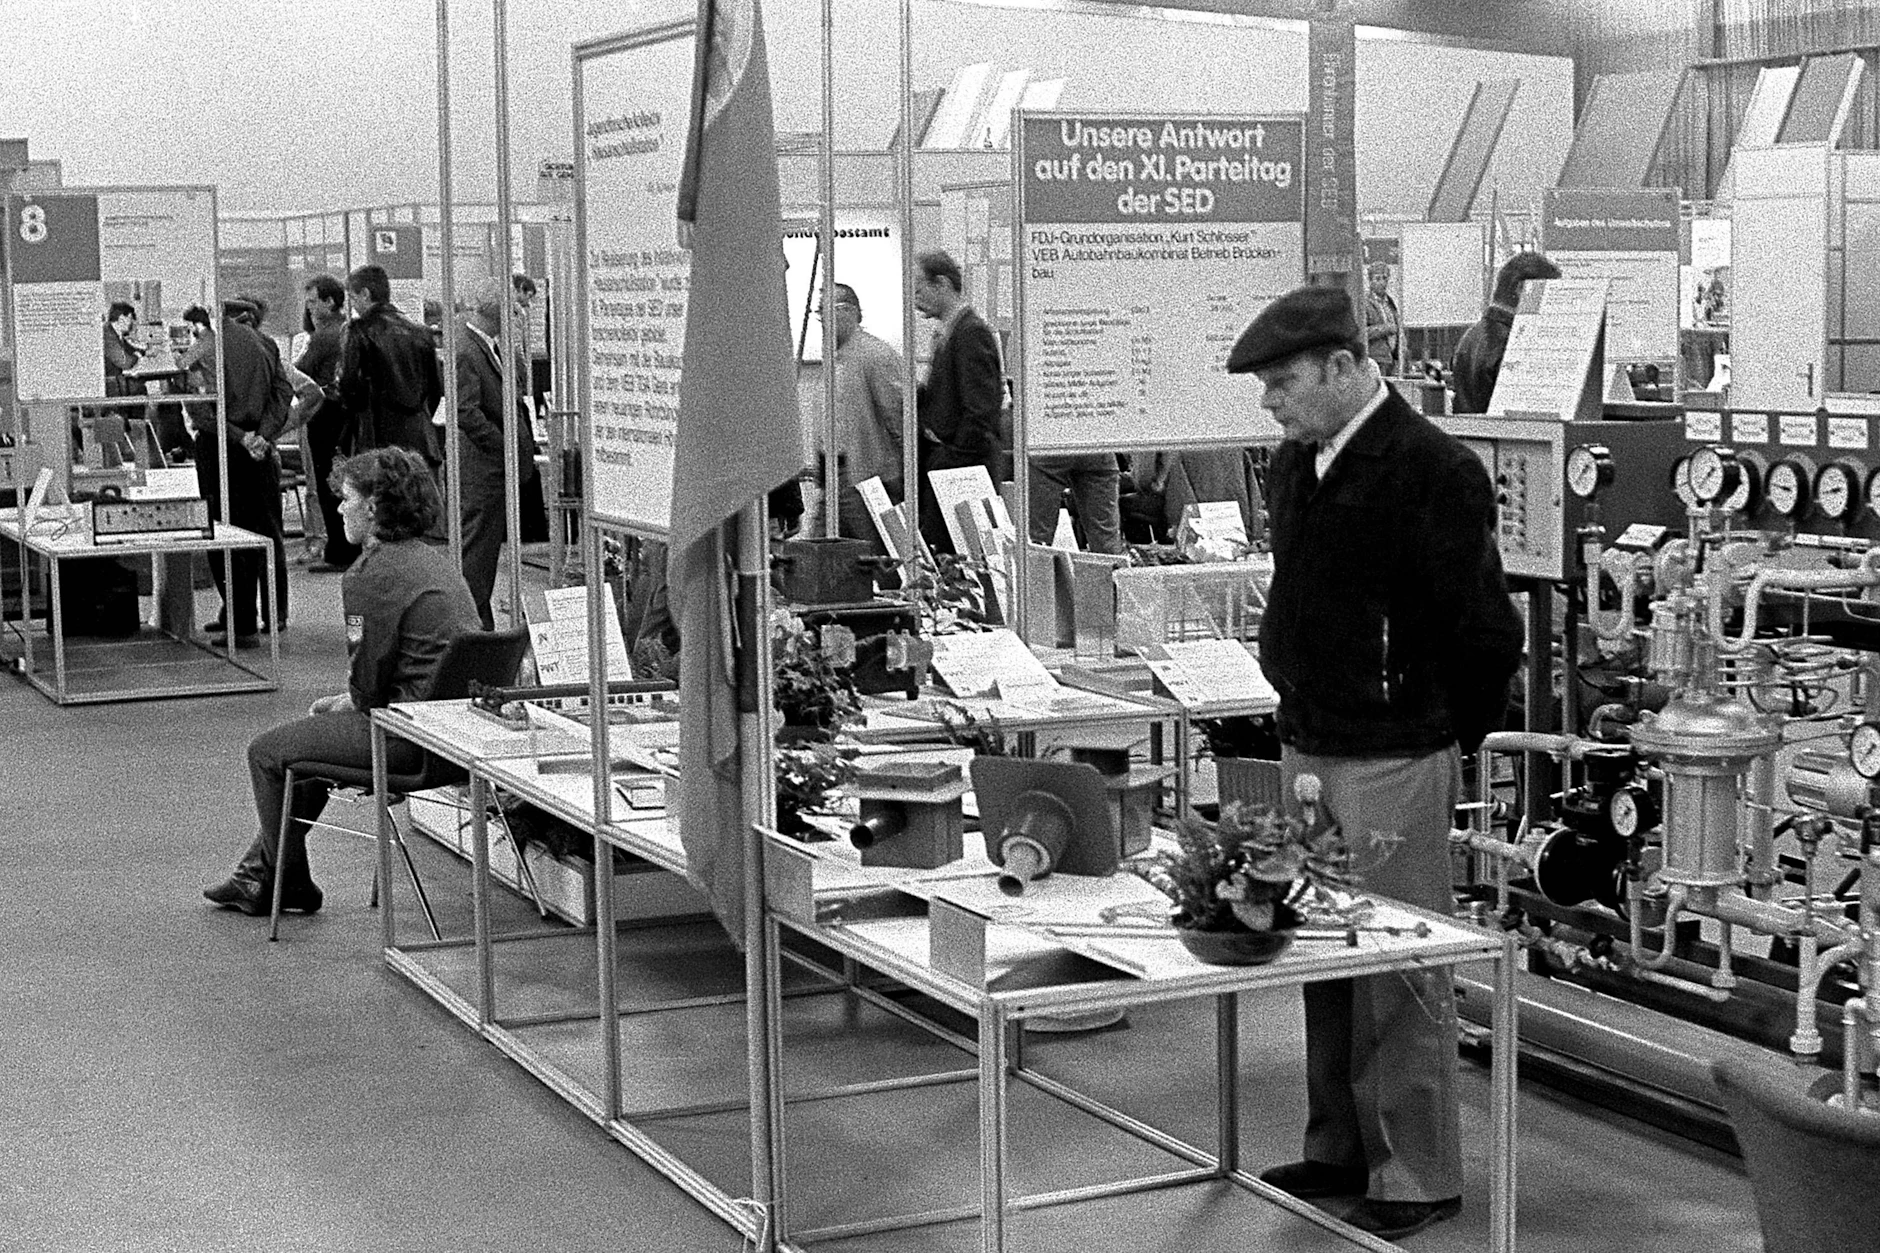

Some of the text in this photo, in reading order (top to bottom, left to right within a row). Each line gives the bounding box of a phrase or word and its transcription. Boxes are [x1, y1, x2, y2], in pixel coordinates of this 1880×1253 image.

[1060, 121, 1265, 148] Unsere Antwort
[1034, 153, 1081, 181] auf
[1086, 153, 1134, 181] den
[1175, 154, 1293, 187] Parteitag
[1117, 187, 1216, 214] der SED
[19, 204, 48, 243] 8
[1032, 248, 1060, 262] VEB
[1062, 248, 1190, 262] Autobahnbaukombinat
[1191, 247, 1231, 261] Betrieb
[1031, 267, 1055, 280] bau
